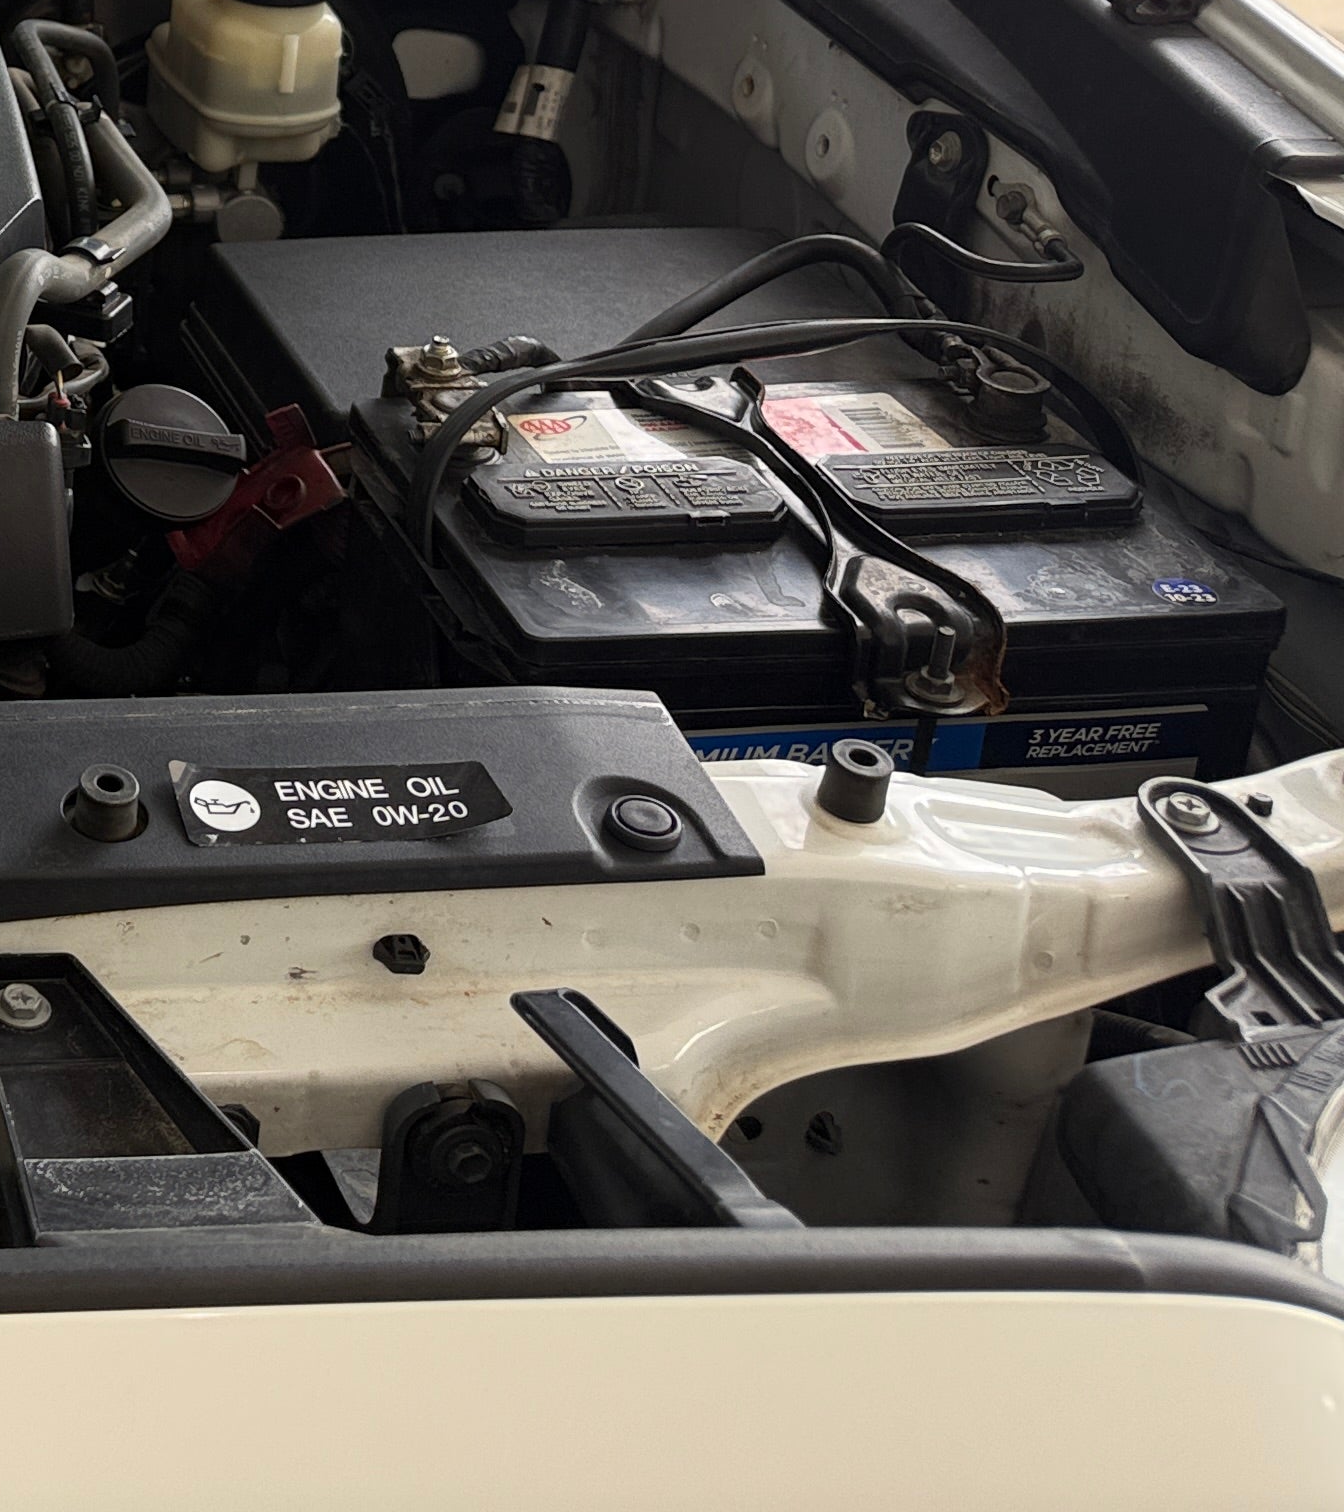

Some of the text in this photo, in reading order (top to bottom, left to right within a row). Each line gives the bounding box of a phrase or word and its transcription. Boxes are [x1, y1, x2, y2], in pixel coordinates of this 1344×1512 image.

[520, 419, 570, 434] AAA
[130, 427, 205, 448] ENGINE OIL
[541, 466, 615, 477] DANGER
[632, 463, 700, 474] POISON
[1028, 722, 1162, 744] 3 YEAR FREE
[1026, 739, 1154, 759] REPLACEMENT
[273, 776, 460, 802] ENGINE OIL
[286, 802, 469, 830] SAE 0W-20
